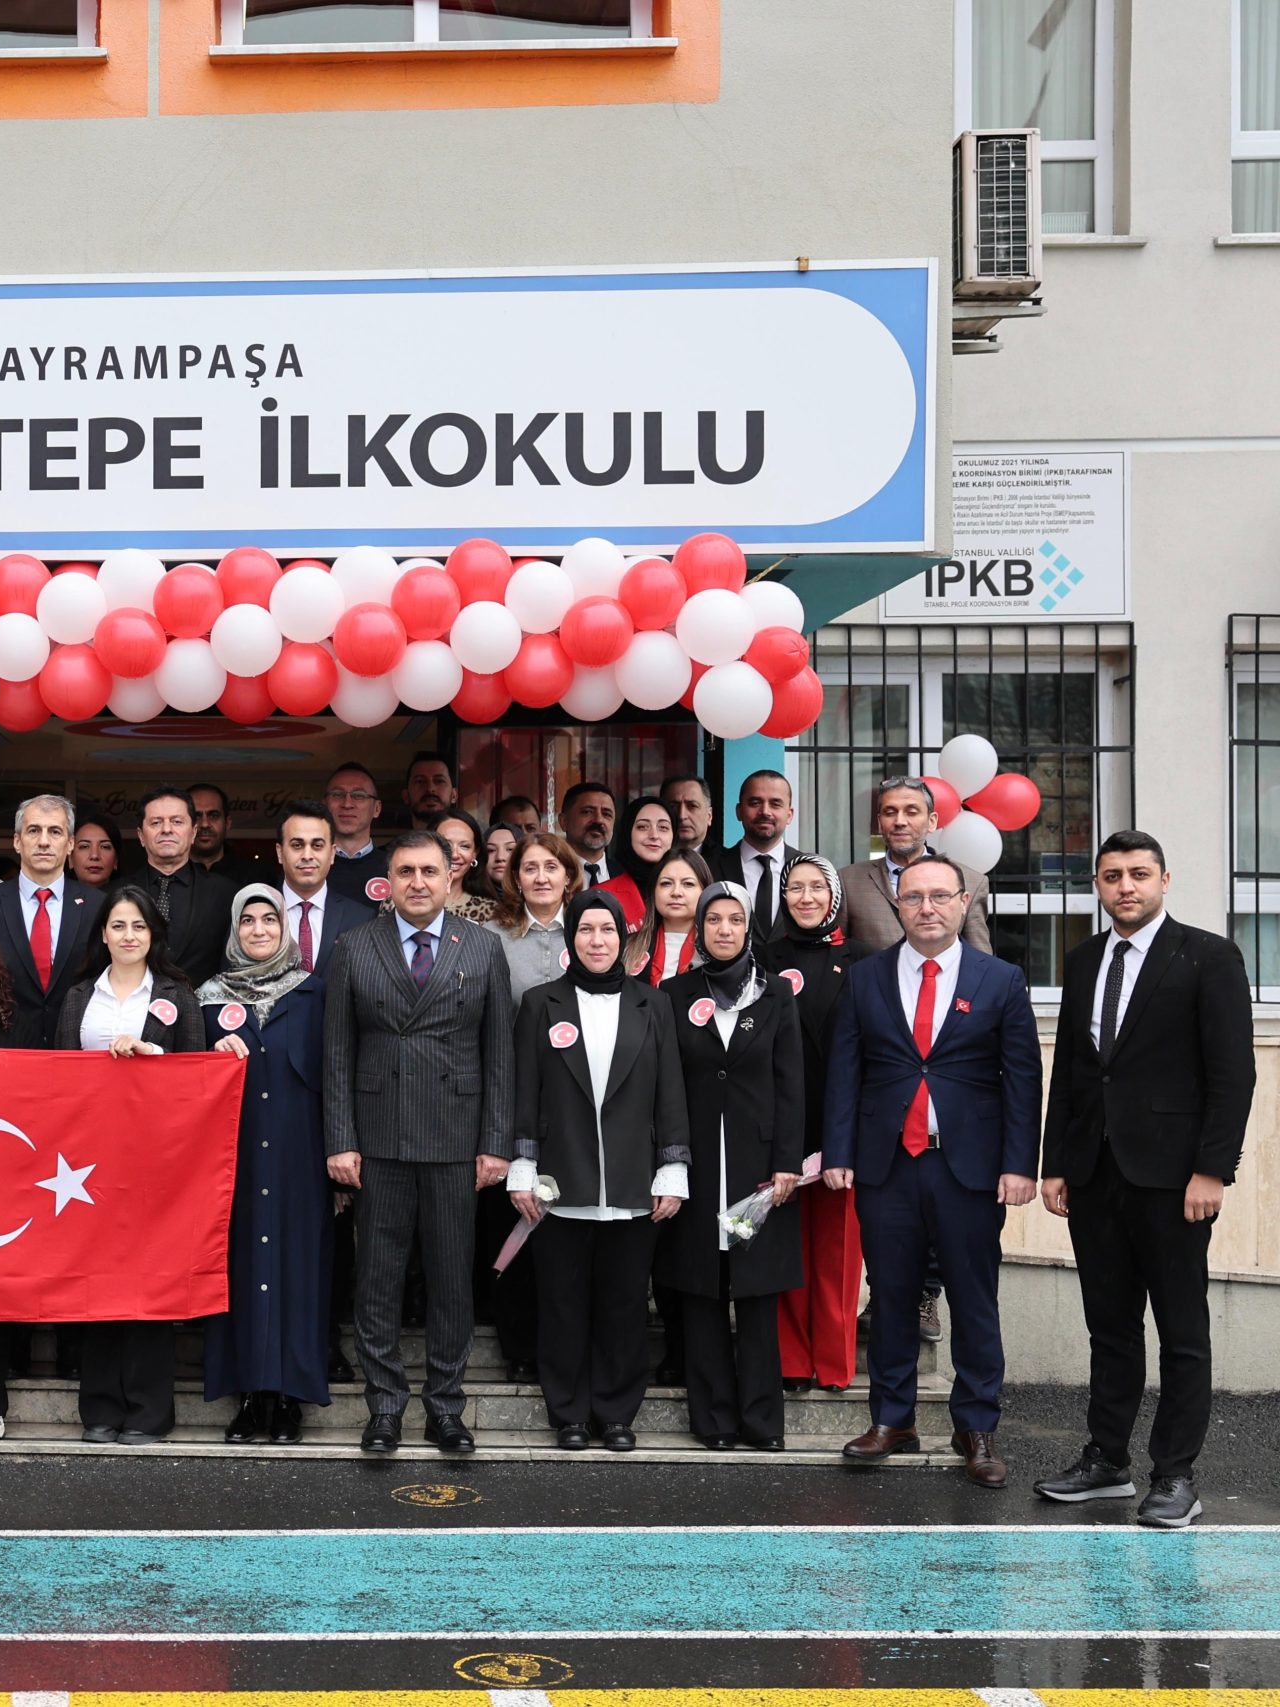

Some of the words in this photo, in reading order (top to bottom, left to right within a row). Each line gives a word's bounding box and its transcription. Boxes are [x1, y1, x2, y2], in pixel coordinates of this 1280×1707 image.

[260, 397, 766, 489] İLKOKULU
[959, 469, 1017, 477] KOORDİNASYON
[1019, 468, 1042, 476] BİRİMİ
[972, 480, 995, 489] KARŞI
[996, 480, 1072, 488] GÜÇLENDİRİLMİŞTİR.
[953, 549, 995, 557] STANBUL
[997, 547, 1035, 556] VALİLİĞİ
[951, 600, 968, 608] PROJE
